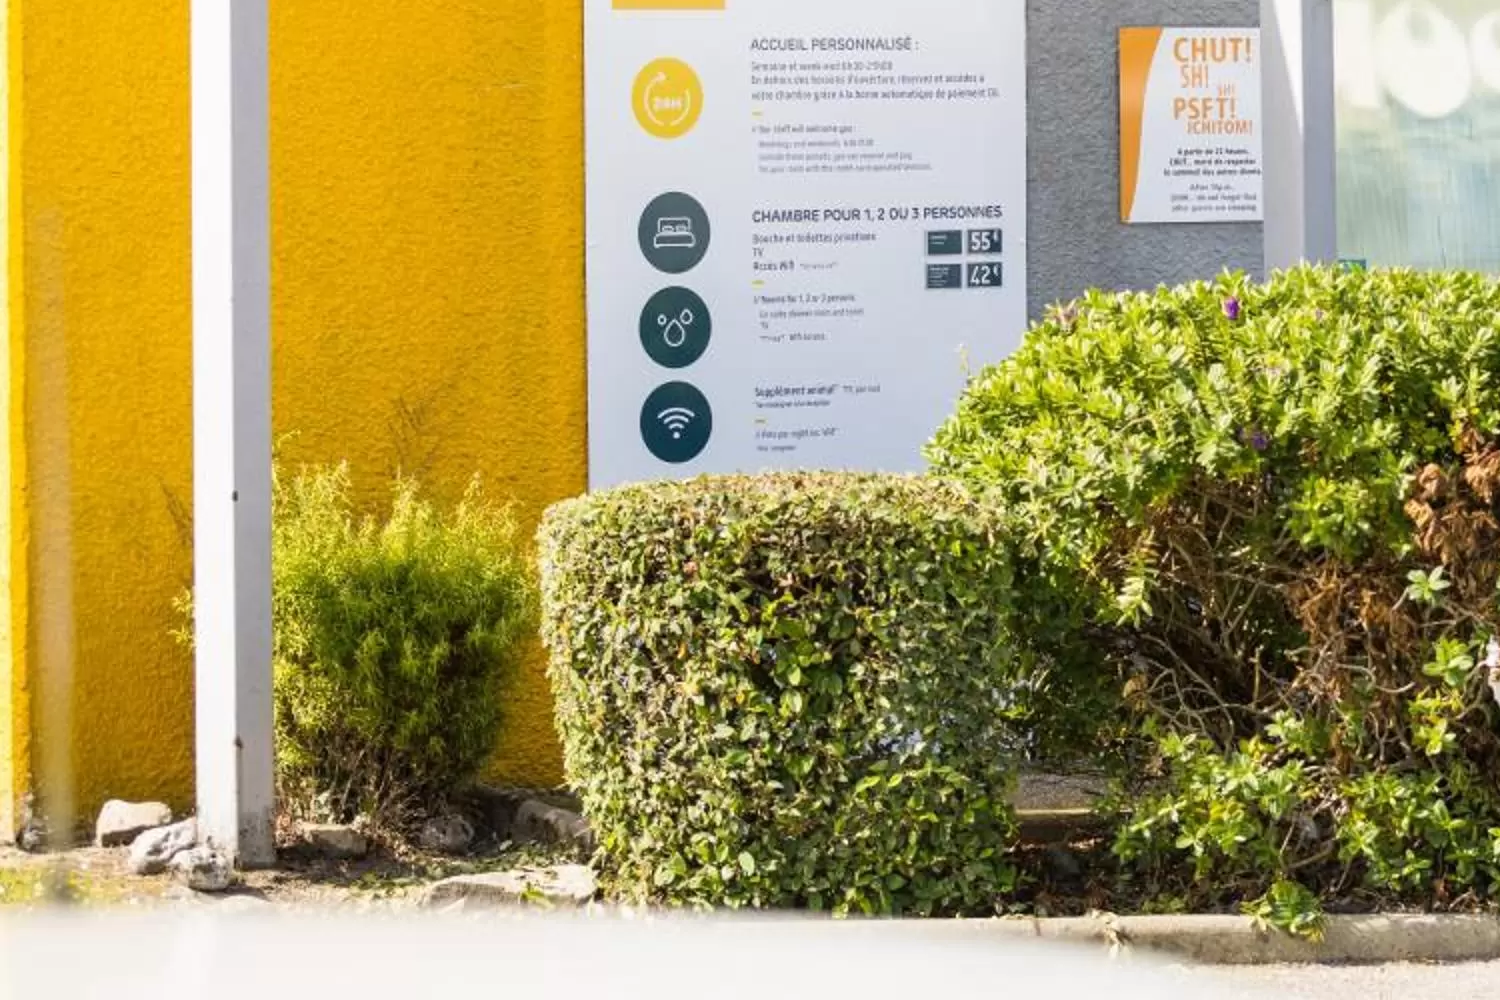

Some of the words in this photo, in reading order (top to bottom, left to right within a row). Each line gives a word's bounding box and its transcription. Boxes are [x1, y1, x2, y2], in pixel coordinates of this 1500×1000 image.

[750, 38, 808, 51] ACCUEIL
[811, 35, 912, 51] PERSONNALISÉ
[1173, 36, 1251, 63] CHUT!
[752, 208, 820, 222] CHAMBRE
[824, 208, 861, 221] POUR
[877, 207, 885, 221] 2
[889, 207, 909, 220] OU
[912, 207, 919, 219] 3
[923, 204, 1003, 219] PERSONNES
